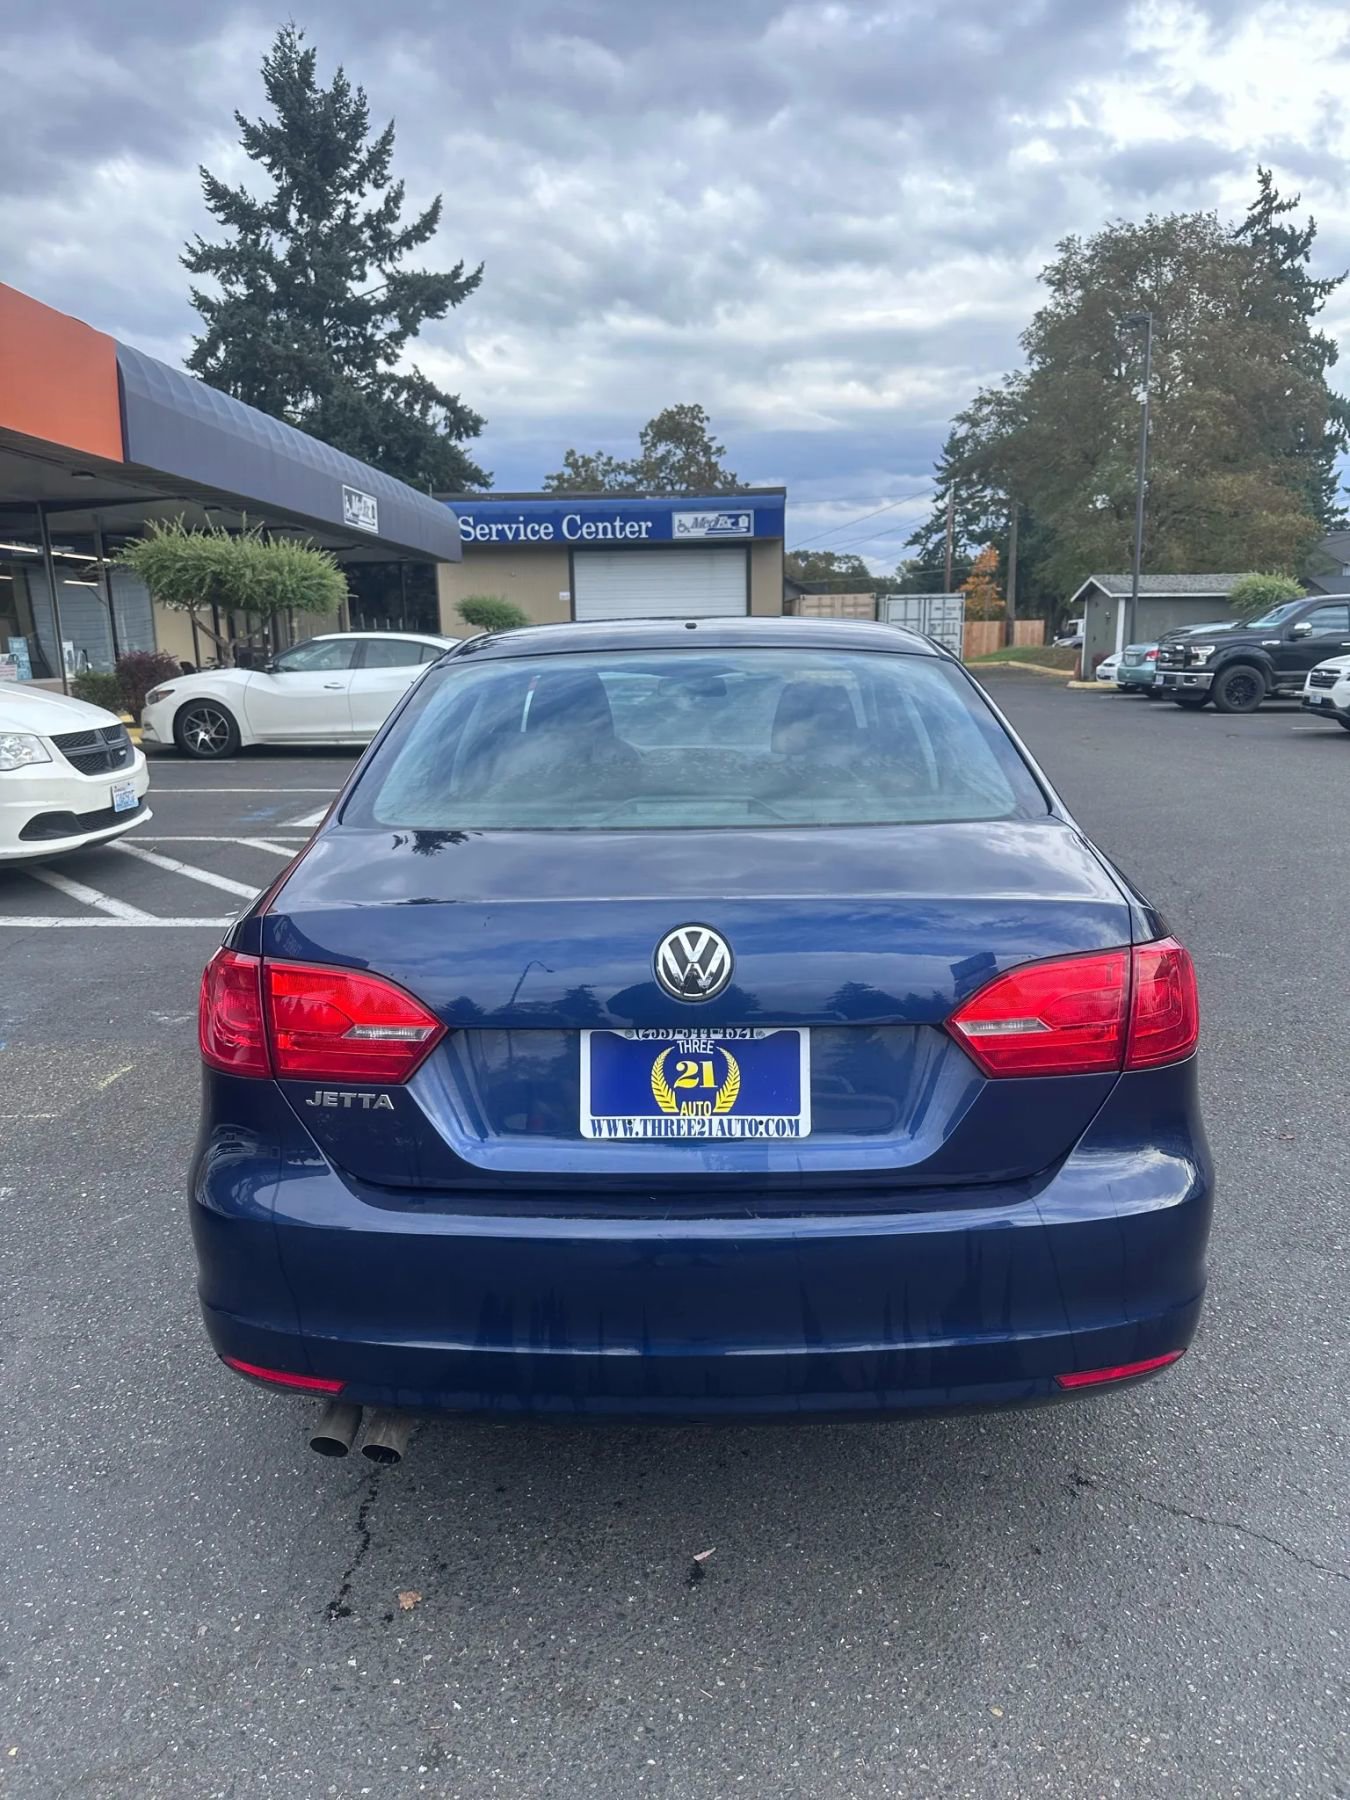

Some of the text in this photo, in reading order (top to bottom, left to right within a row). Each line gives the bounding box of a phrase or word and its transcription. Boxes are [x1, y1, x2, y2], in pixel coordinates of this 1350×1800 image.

[458, 514, 652, 541] Service Center
[676, 1040, 715, 1054] THREE
[673, 1061, 718, 1089] 21
[305, 1091, 395, 1110] JETTA
[680, 1101, 712, 1117] AUTO
[590, 1118, 801, 1137] WWW.THREE21AUTO.COM
